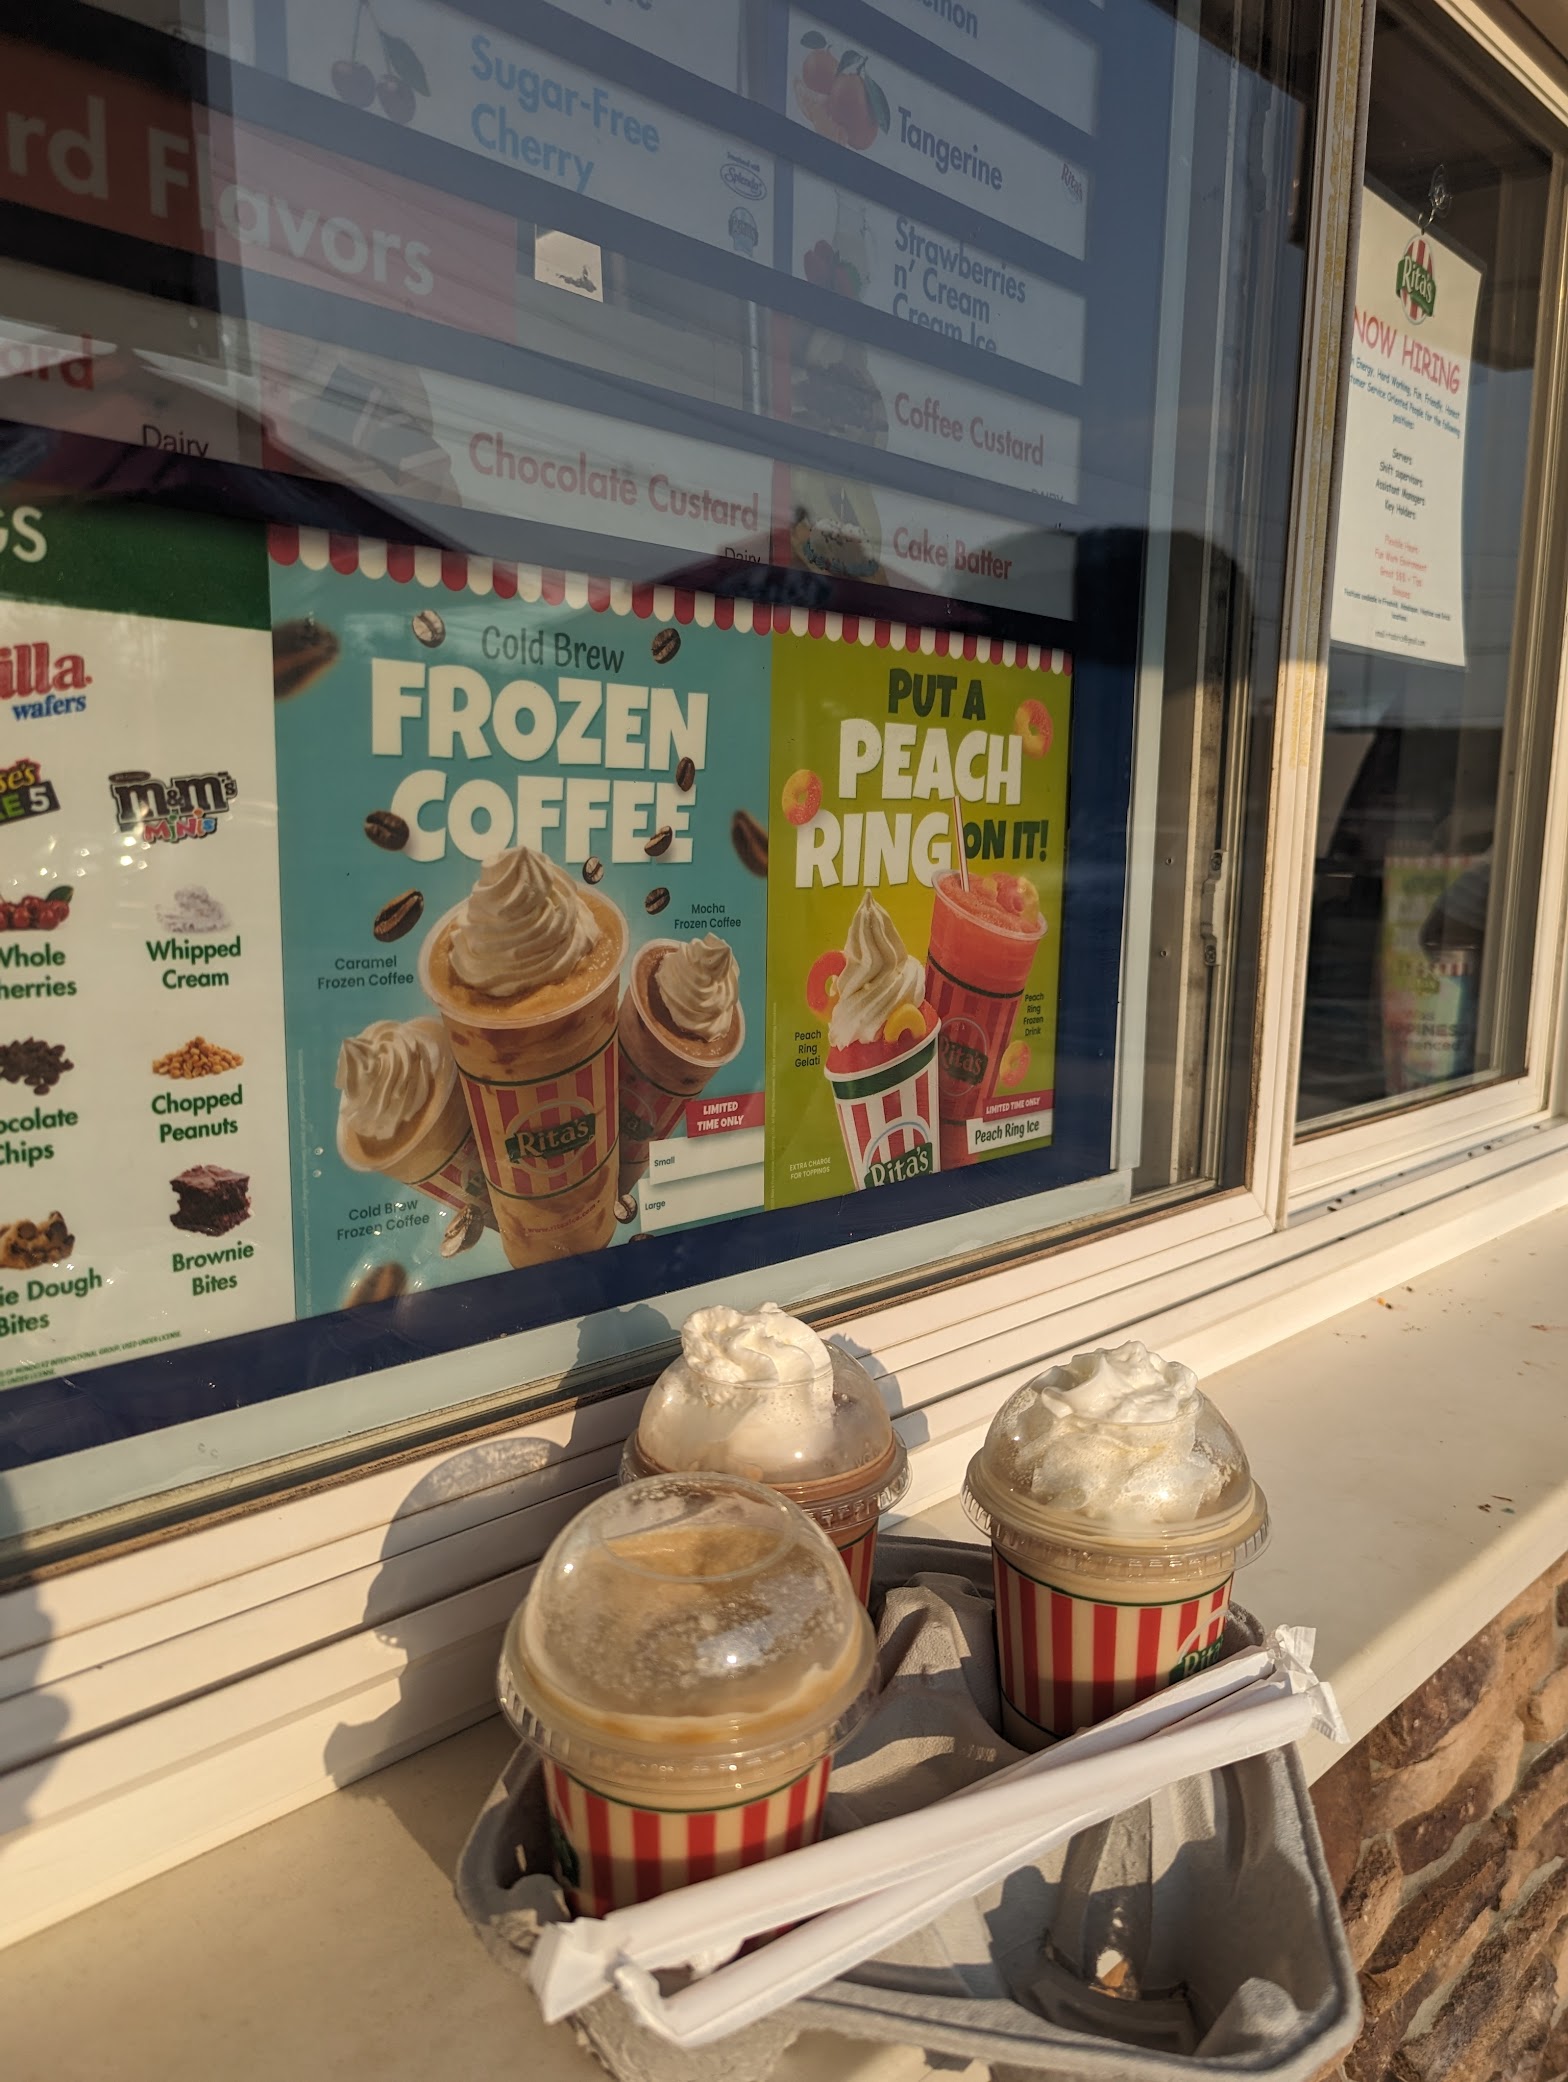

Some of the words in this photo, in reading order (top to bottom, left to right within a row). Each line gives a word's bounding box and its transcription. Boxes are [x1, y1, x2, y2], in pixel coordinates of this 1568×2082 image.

[470, 35, 660, 153] Sugar-Free
[471, 102, 594, 193] Cherry
[898, 106, 1003, 191] Tangerine
[895, 215, 1026, 303] Strawberries
[1402, 255, 1433, 304] Rita's
[923, 265, 990, 324] Cream
[1354, 305, 1397, 359] NOW
[1402, 335, 1460, 394] HIRING
[142, 425, 209, 458] Dairy
[894, 392, 963, 442] Coffee
[970, 416, 1045, 467] Custard
[469, 430, 637, 505] Chocolate
[648, 473, 759, 532] Custard
[0, 506, 48, 563] S
[893, 527, 949, 568] Cake
[955, 538, 1012, 581] Batter
[481, 625, 544, 665] Cold
[554, 631, 625, 674] Brew
[888, 668, 957, 718] PUT
[962, 679, 986, 721] A
[12, 694, 87, 722] wafers
[371, 657, 709, 772] FROZEN
[839, 718, 1022, 805] PEACH
[29, 786, 48, 812] 5
[390, 769, 696, 864] COFFEE
[795, 808, 951, 888] RING
[963, 820, 1006, 860] ON
[1012, 820, 1049, 862] IT!
[691, 903, 725, 914] Mocha
[674, 919, 707, 929] Frozen
[709, 917, 741, 928] Coffee
[146, 936, 242, 965] Whipped
[335, 955, 397, 970] Caramel
[162, 968, 229, 990] Cream
[318, 976, 365, 990] Frozen
[369, 972, 414, 987] Coffee
[1025, 993, 1044, 1002] Peach
[1027, 1004, 1041, 1014] Ring
[1023, 1016, 1043, 1025] Frozen
[1025, 1027, 1041, 1036] Drink
[794, 1030, 821, 1041] Peach
[794, 1057, 820, 1067] Gelati
[798, 1043, 817, 1055] Ring
[151, 1084, 244, 1117] Chopped
[702, 1101, 739, 1116] LIMITED
[986, 1102, 1010, 1114] LIMITED
[1010, 1100, 1025, 1111] TIME
[1026, 1097, 1040, 1107] ONLY
[160, 1117, 239, 1143] Peanuts
[697, 1118, 720, 1131] TIME
[721, 1114, 745, 1127] ONLY
[975, 1127, 1002, 1145] Peach
[1005, 1123, 1025, 1138] Ring
[1026, 1119, 1039, 1133] Ice
[515, 1118, 590, 1158] Rita's
[654, 1157, 675, 1167] Small
[789, 1161, 807, 1171] EXTRA
[808, 1157, 831, 1168] CHARGE
[790, 1171, 802, 1180] FOR
[803, 1166, 830, 1177] TOPPINGS
[348, 1206, 381, 1220] Cold
[385, 1200, 418, 1215] Brew
[645, 1200, 666, 1211] Large
[337, 1224, 382, 1240] Frozen
[386, 1214, 430, 1231] Coffee
[172, 1241, 255, 1273] Brownie
[27, 1267, 102, 1301] Dough
[192, 1273, 238, 1297] Bites
